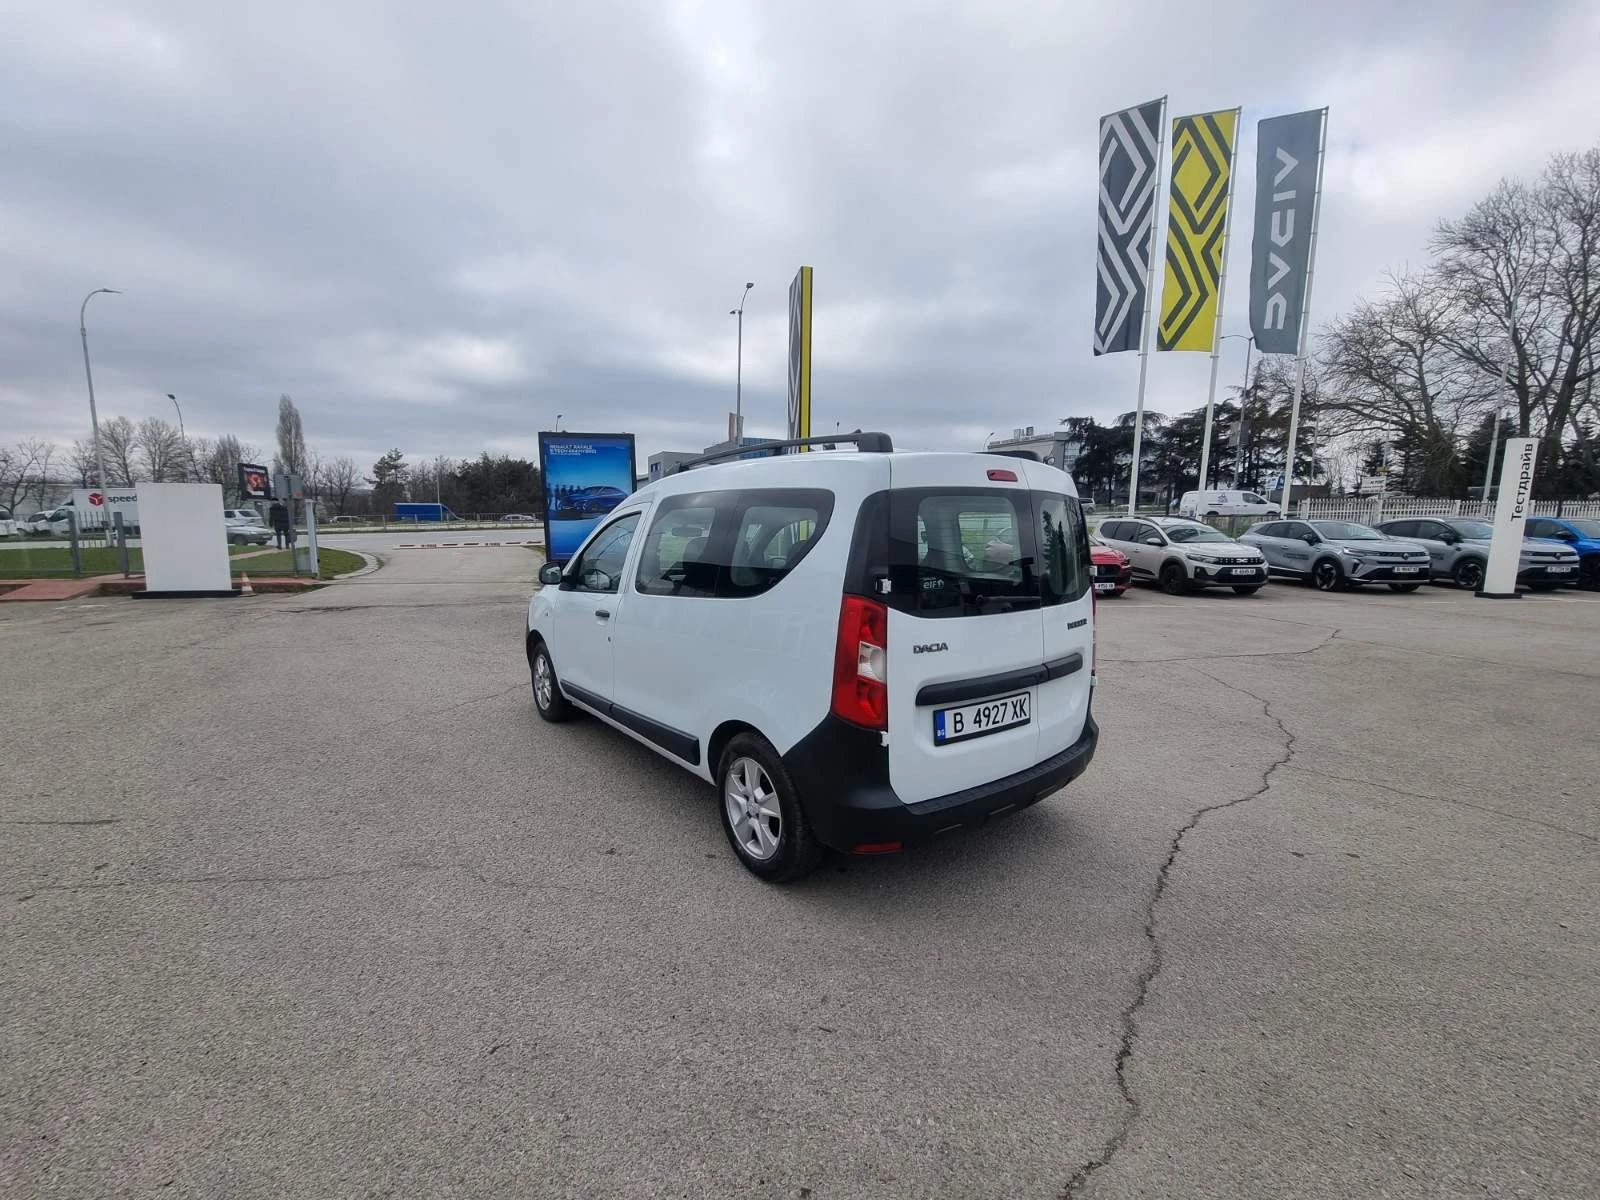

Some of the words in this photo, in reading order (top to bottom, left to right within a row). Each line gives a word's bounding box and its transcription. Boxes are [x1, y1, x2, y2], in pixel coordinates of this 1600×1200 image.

[1510, 443, 1534, 522] Тестдрайв
[912, 642, 949, 654] DACIA
[953, 712, 965, 734] B
[973, 702, 1008, 728] 4927
[1011, 697, 1028, 721] XK
